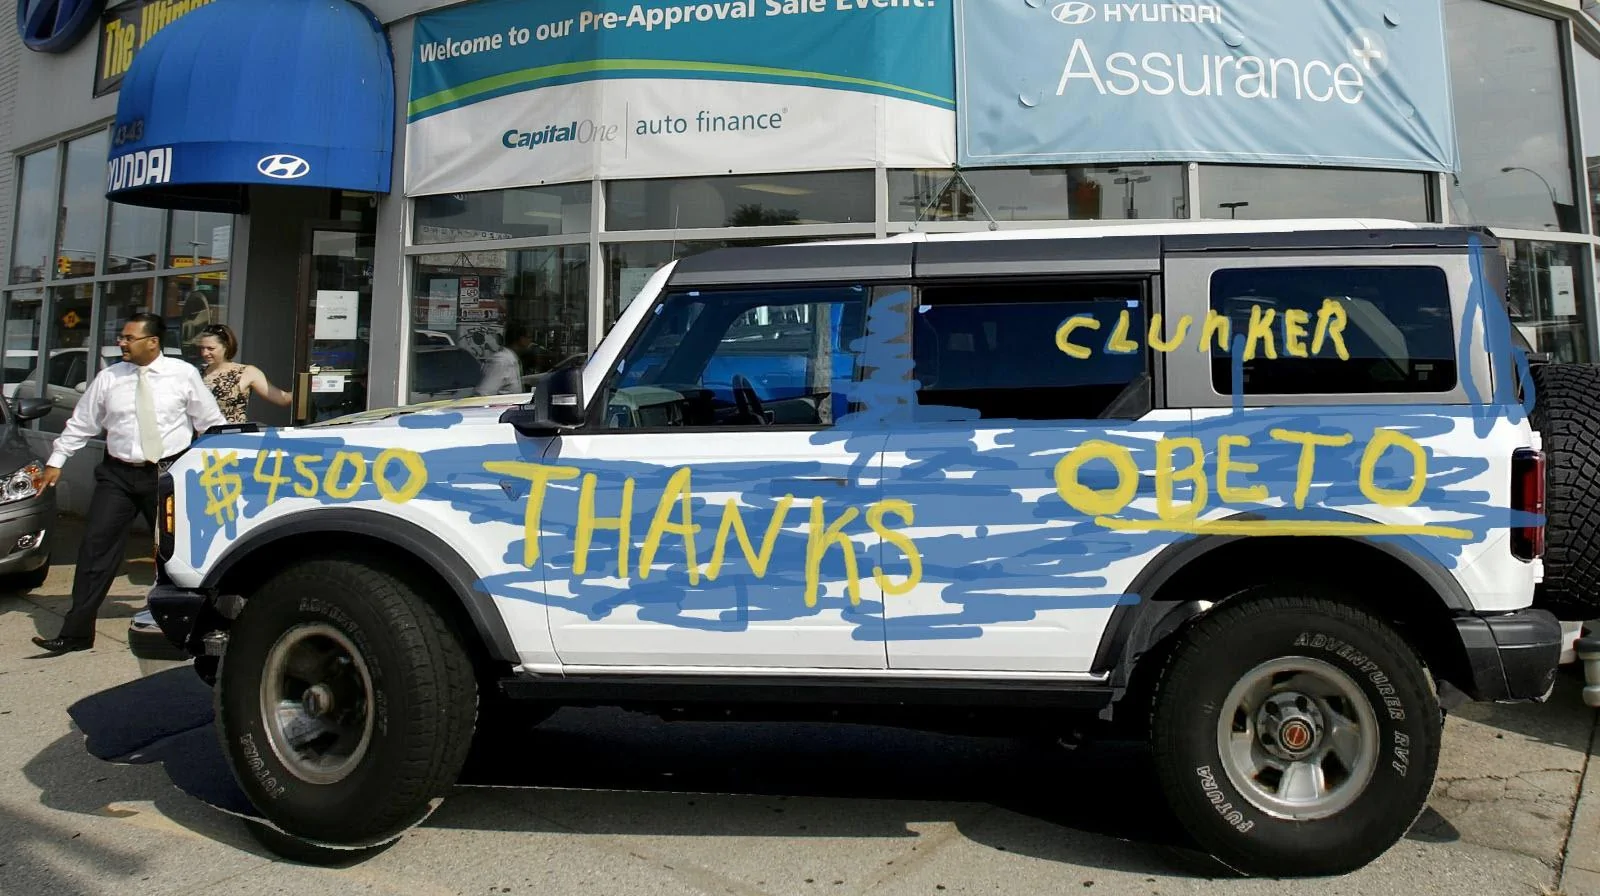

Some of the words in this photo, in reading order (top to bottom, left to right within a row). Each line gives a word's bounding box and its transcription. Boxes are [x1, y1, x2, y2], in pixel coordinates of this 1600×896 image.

[420, 38, 503, 63] Welcome
[508, 26, 530, 46] to
[536, 19, 574, 42] our
[579, 0, 755, 33] Pre-Approval
[1104, 3, 1222, 24] HYUNDAI
[103, 18, 135, 80] The
[636, 115, 688, 136] auto
[107, 148, 172, 192] YUNDAI
[200, 447, 428, 526] $4500
[1054, 428, 1427, 522] OBETO
[482, 461, 923, 607] THANKS
[1294, 632, 1406, 721] ADVENTURER
[1391, 730, 1410, 777] RVT
[1197, 765, 1255, 833] FUTURA
